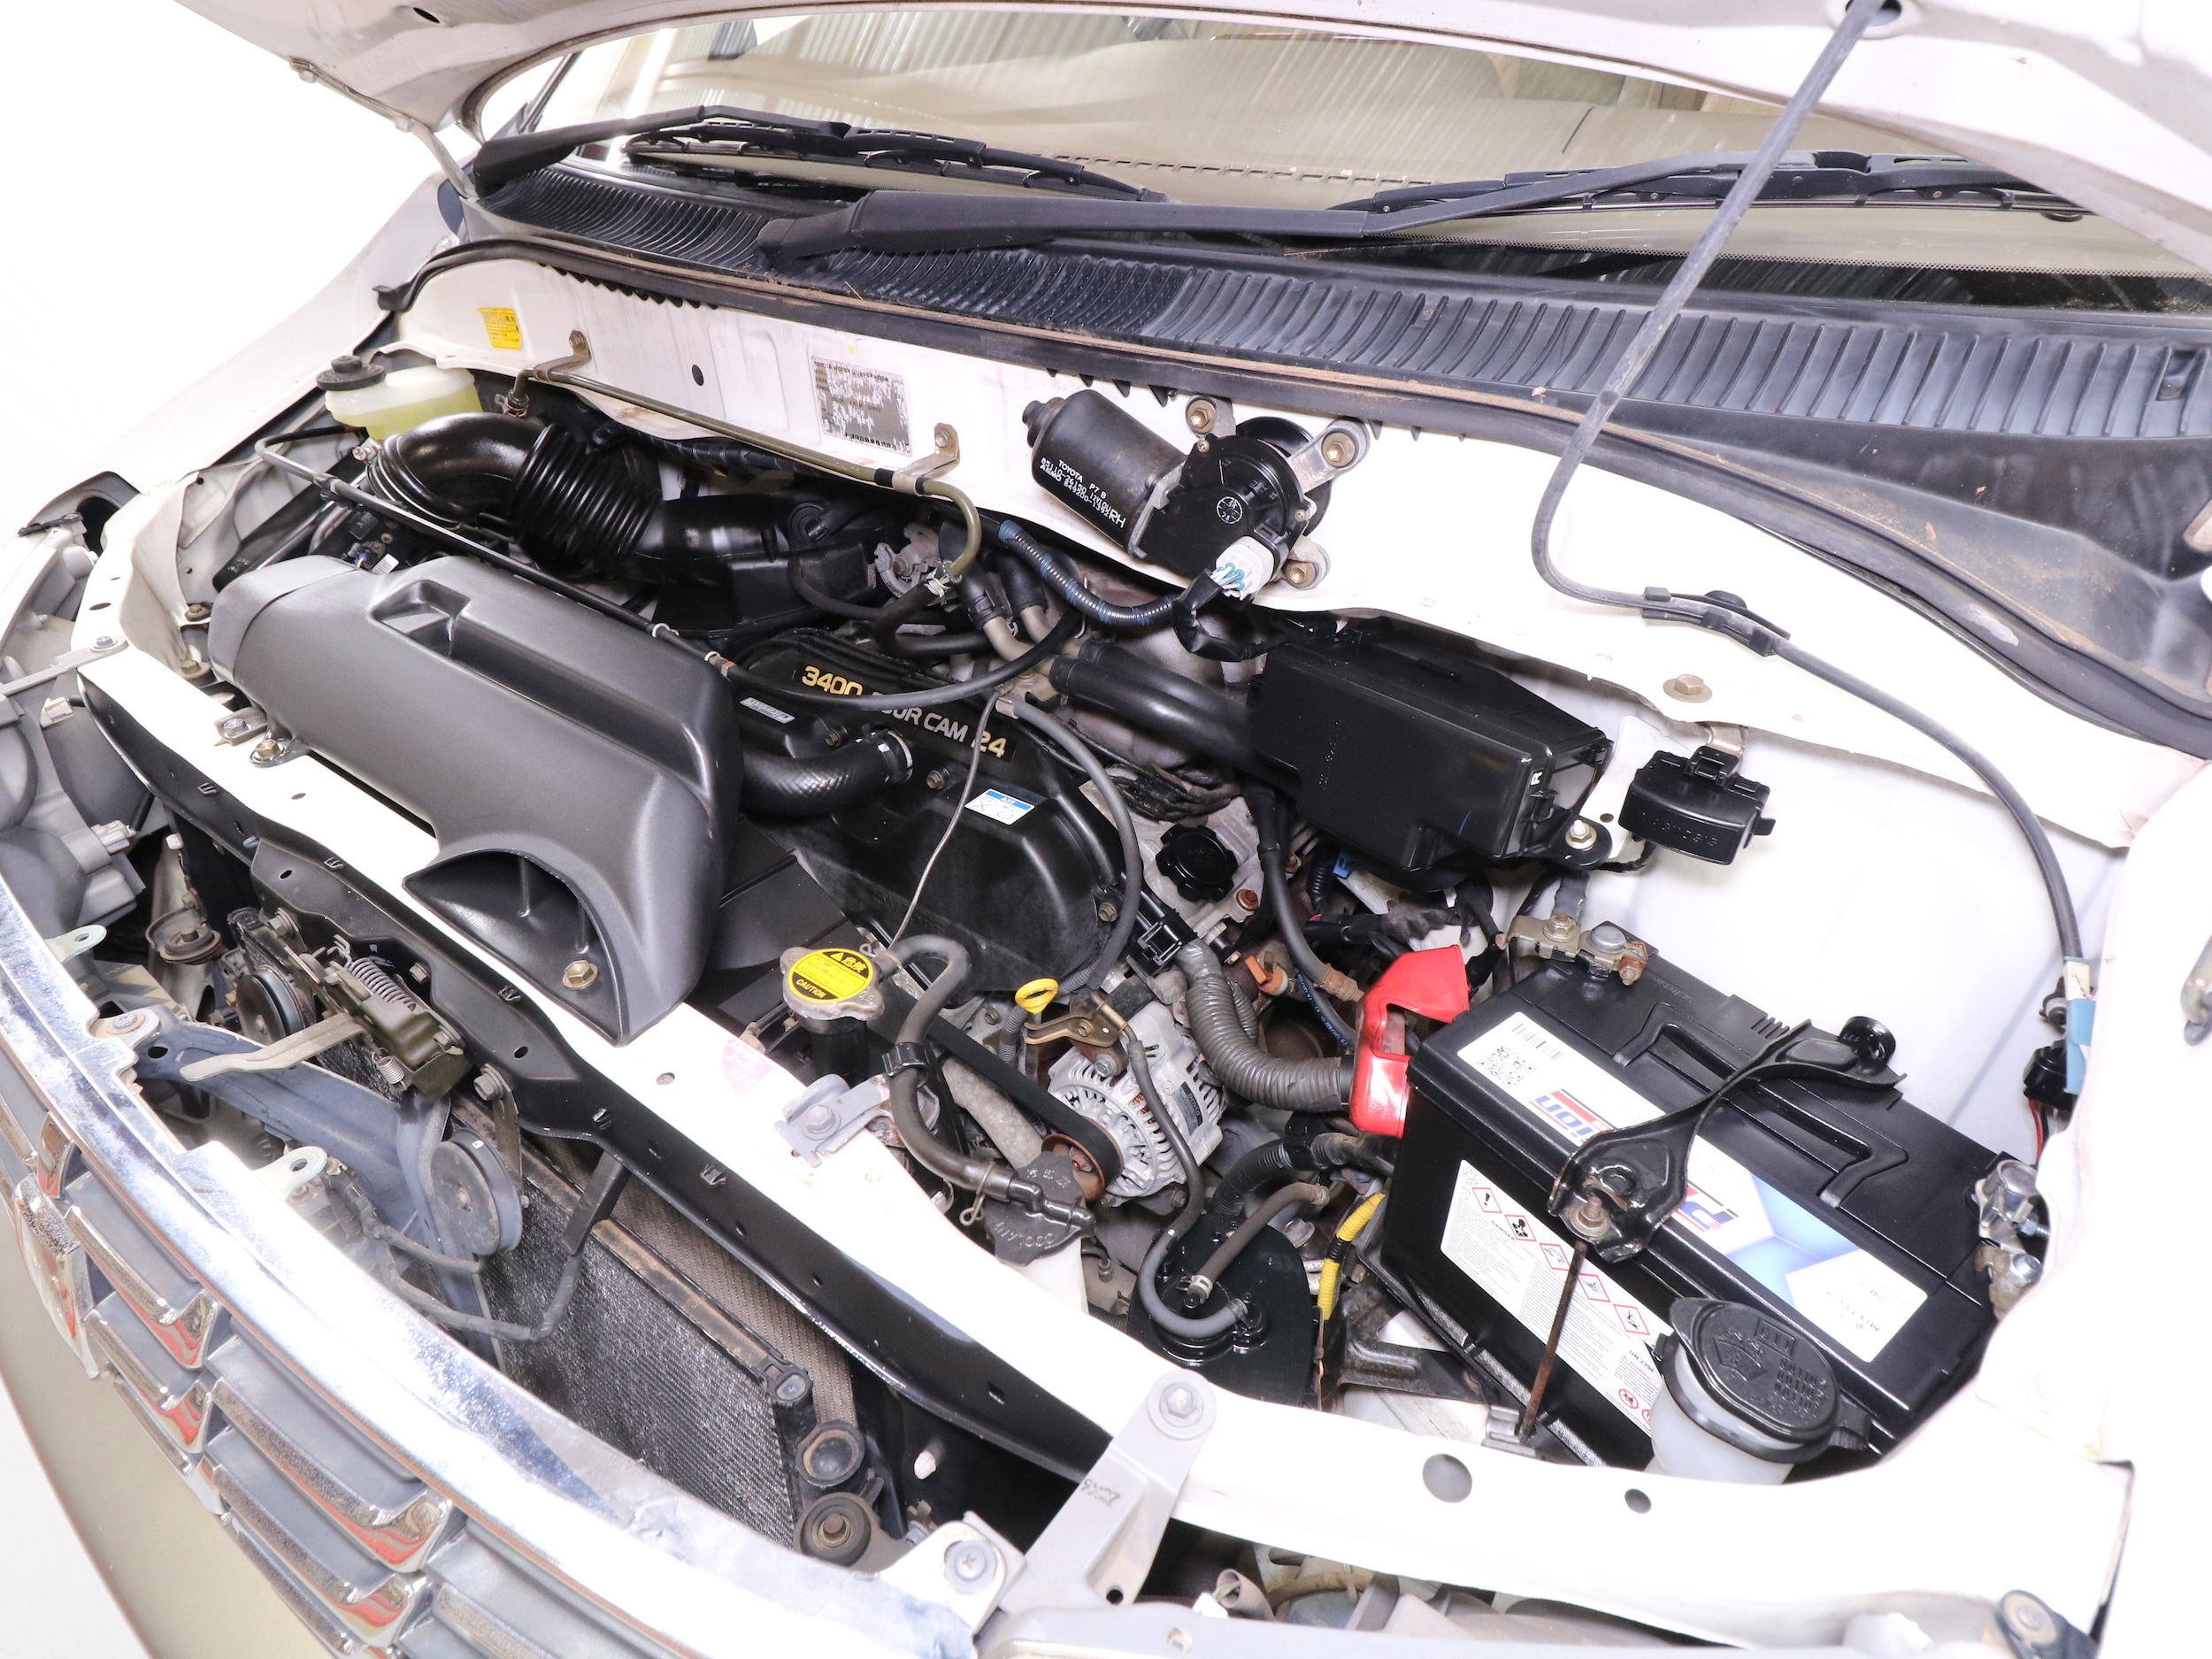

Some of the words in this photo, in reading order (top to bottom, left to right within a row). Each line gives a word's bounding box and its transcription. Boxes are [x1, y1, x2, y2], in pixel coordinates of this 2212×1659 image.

[1040, 465, 1062, 482] ASMO
[1041, 457, 1087, 494] 85110-26150
[1058, 459, 1084, 483] TOYOTA
[1089, 483, 1100, 493] P7
[1109, 509, 1126, 528] RH
[802, 665, 864, 696] 3400
[924, 712, 969, 742] CAM
[971, 730, 1007, 758] 24
[795, 979, 826, 999] CAUTION
[1188, 1094, 1201, 1116] DENSO
[1629, 1350, 1640, 1360] UN
